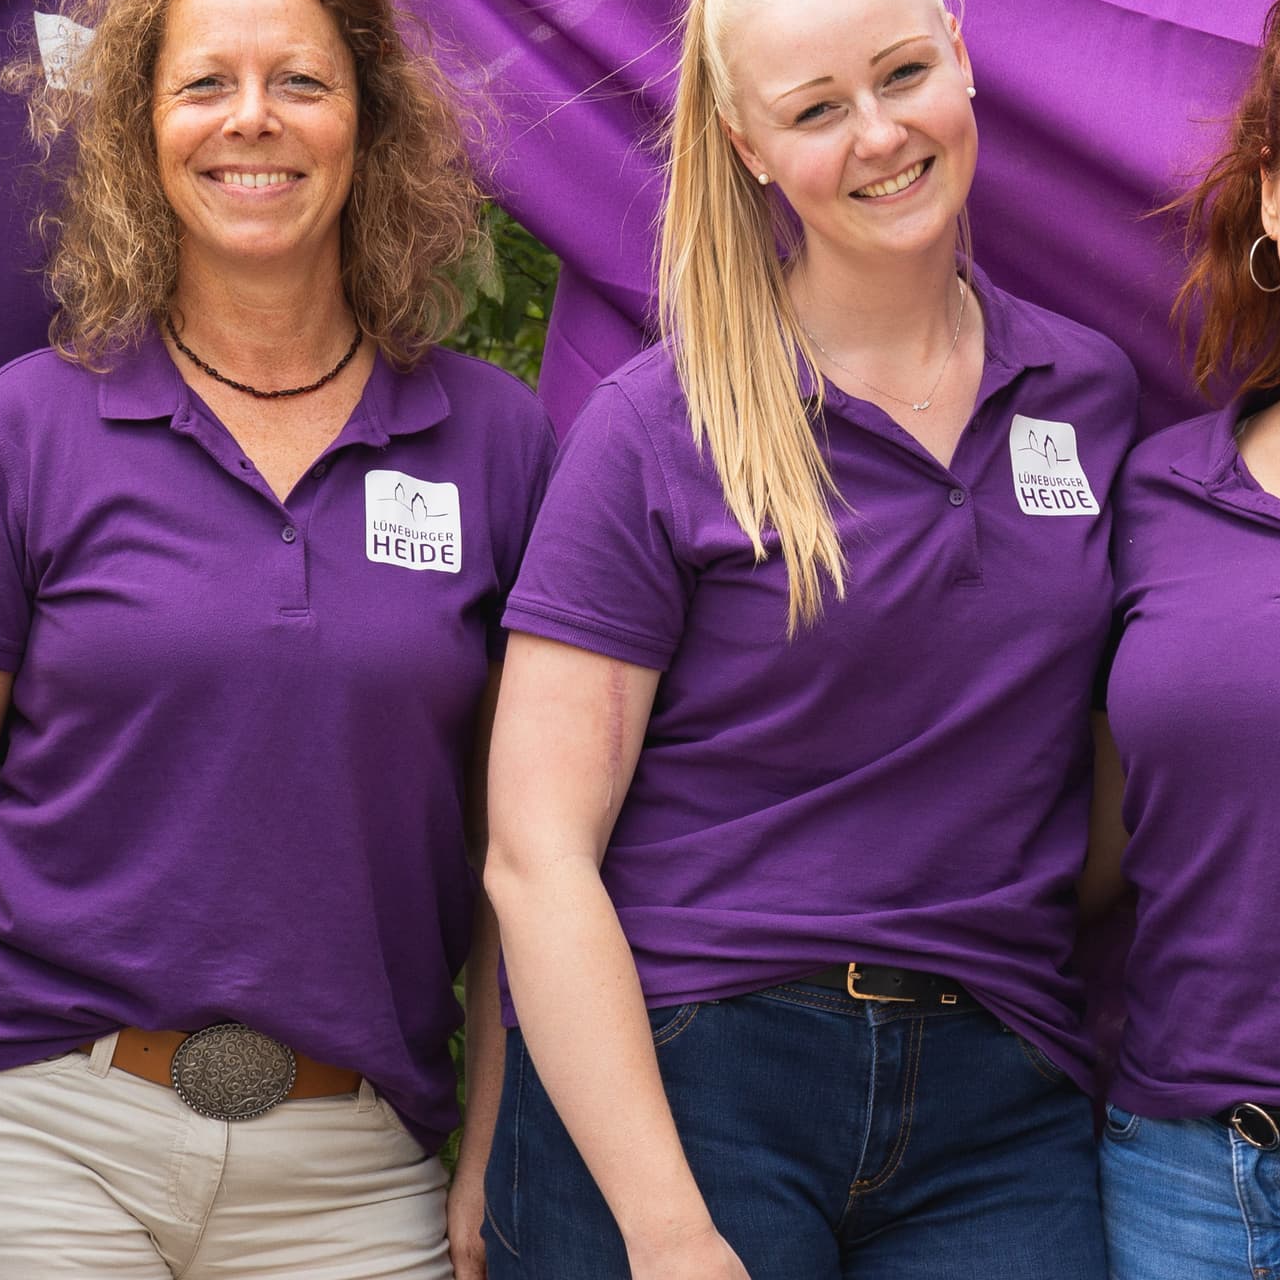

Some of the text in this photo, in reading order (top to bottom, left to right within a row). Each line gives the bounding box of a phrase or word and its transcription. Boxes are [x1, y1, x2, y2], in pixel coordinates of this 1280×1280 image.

[1018, 471, 1084, 487] LÜNEBURGER
[1020, 487, 1093, 509] HEIDE
[373, 519, 454, 542] LÜNEBURGER
[373, 534, 455, 565] HEIDE
